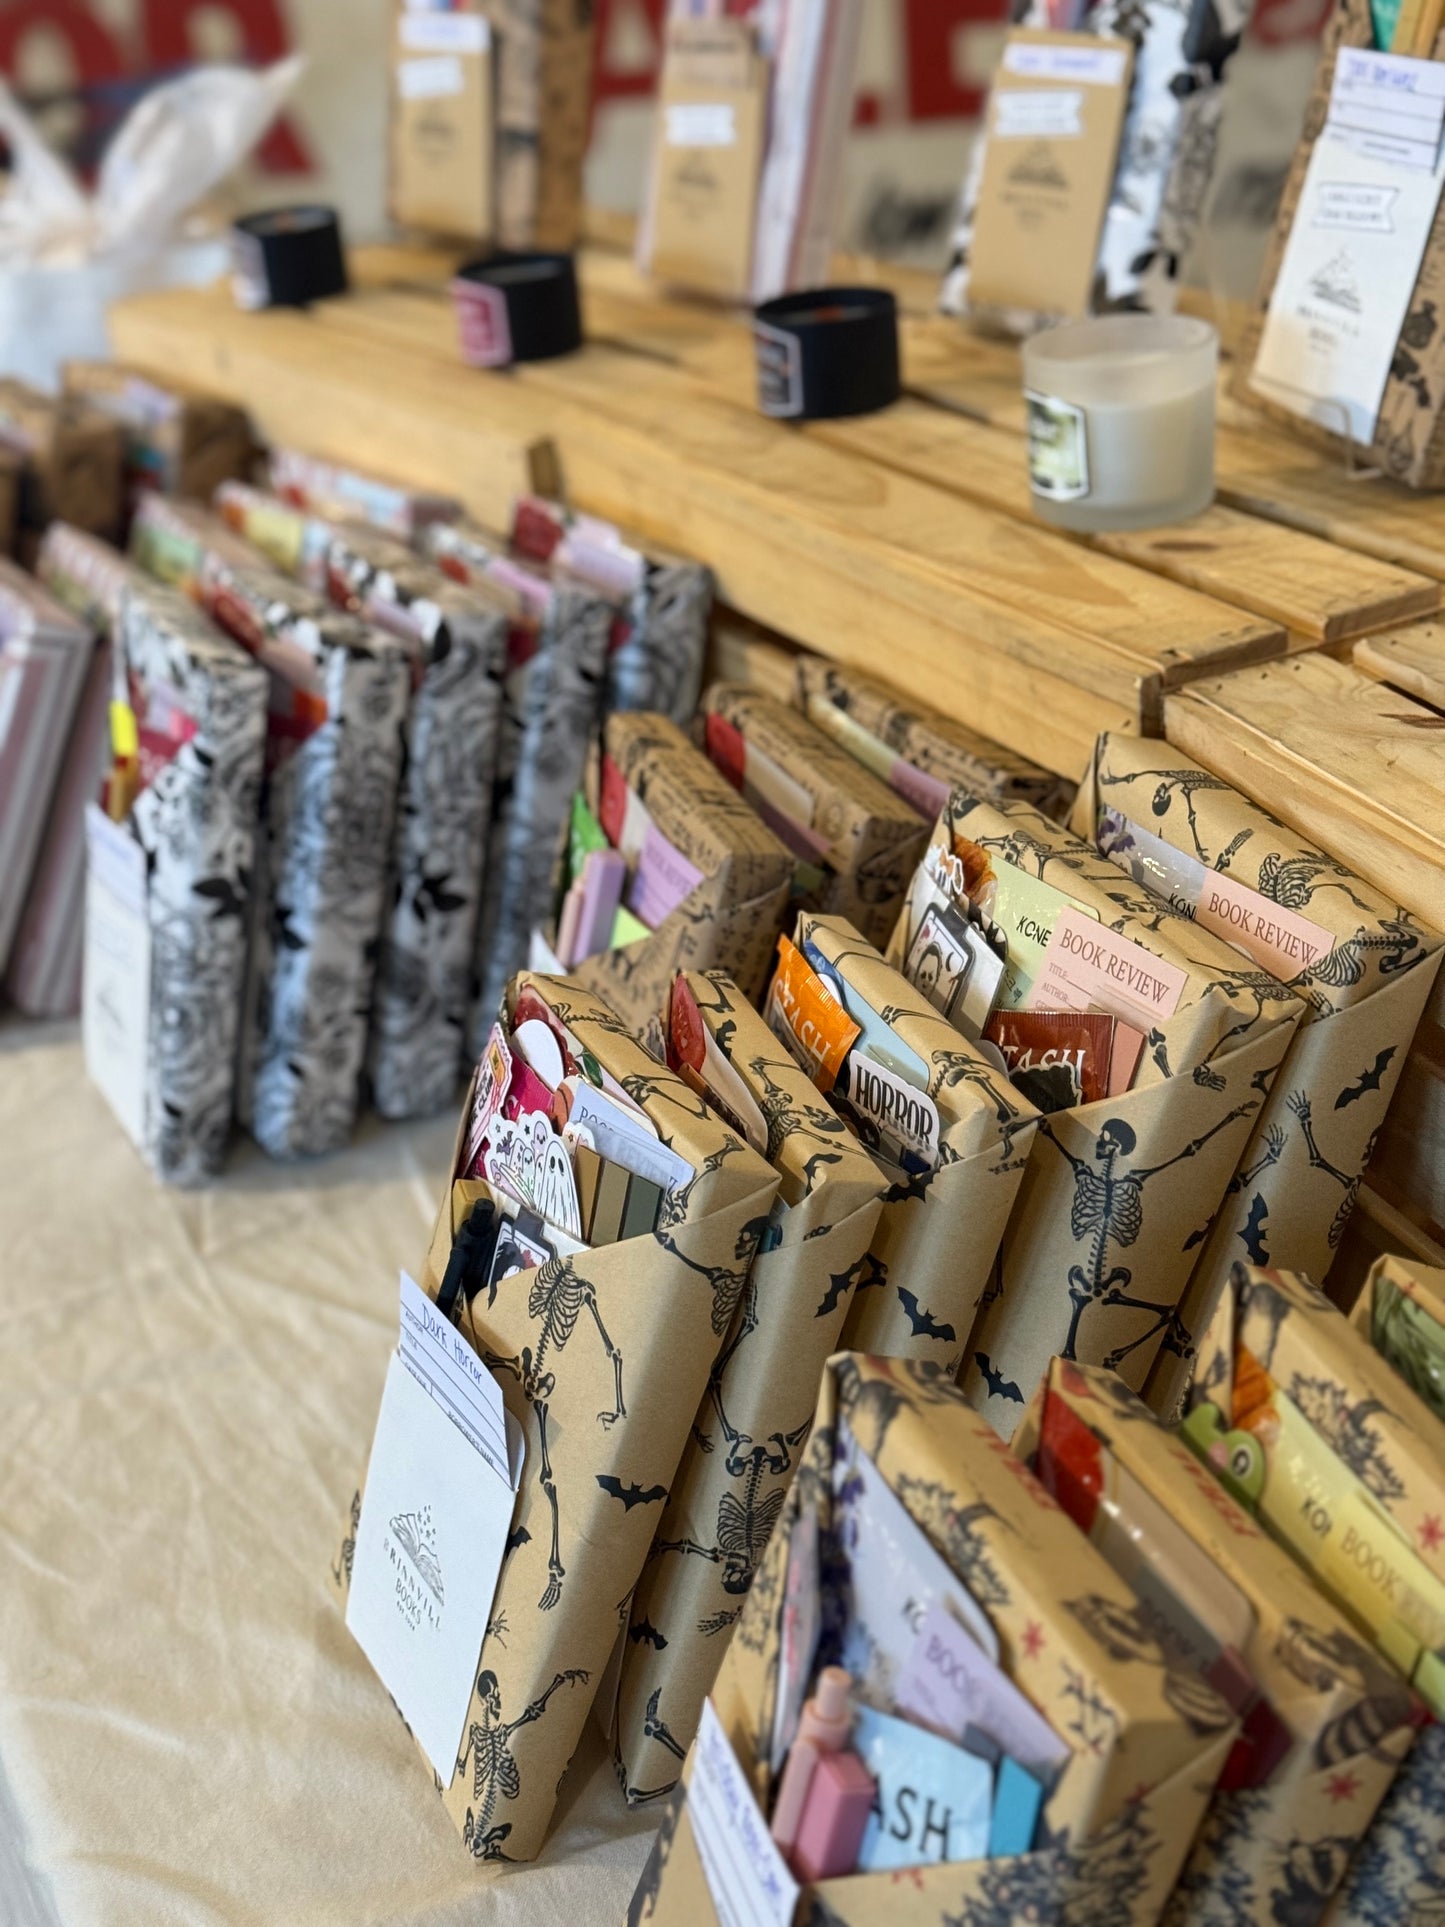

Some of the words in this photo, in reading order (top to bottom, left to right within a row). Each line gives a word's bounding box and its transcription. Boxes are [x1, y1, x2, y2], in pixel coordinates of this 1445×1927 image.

[1059, 927, 1106, 969] BOOK
[1105, 953, 1170, 1004] REVIEW
[1208, 892, 1254, 933] BOOK
[1253, 916, 1319, 966] REVIEW
[856, 1064, 933, 1151] HORROR
[422, 1303, 447, 1349] Dark
[454, 1338, 482, 1385] Horror
[396, 1577, 421, 1625] BOOKS
[1339, 1525, 1402, 1602] BOOK
